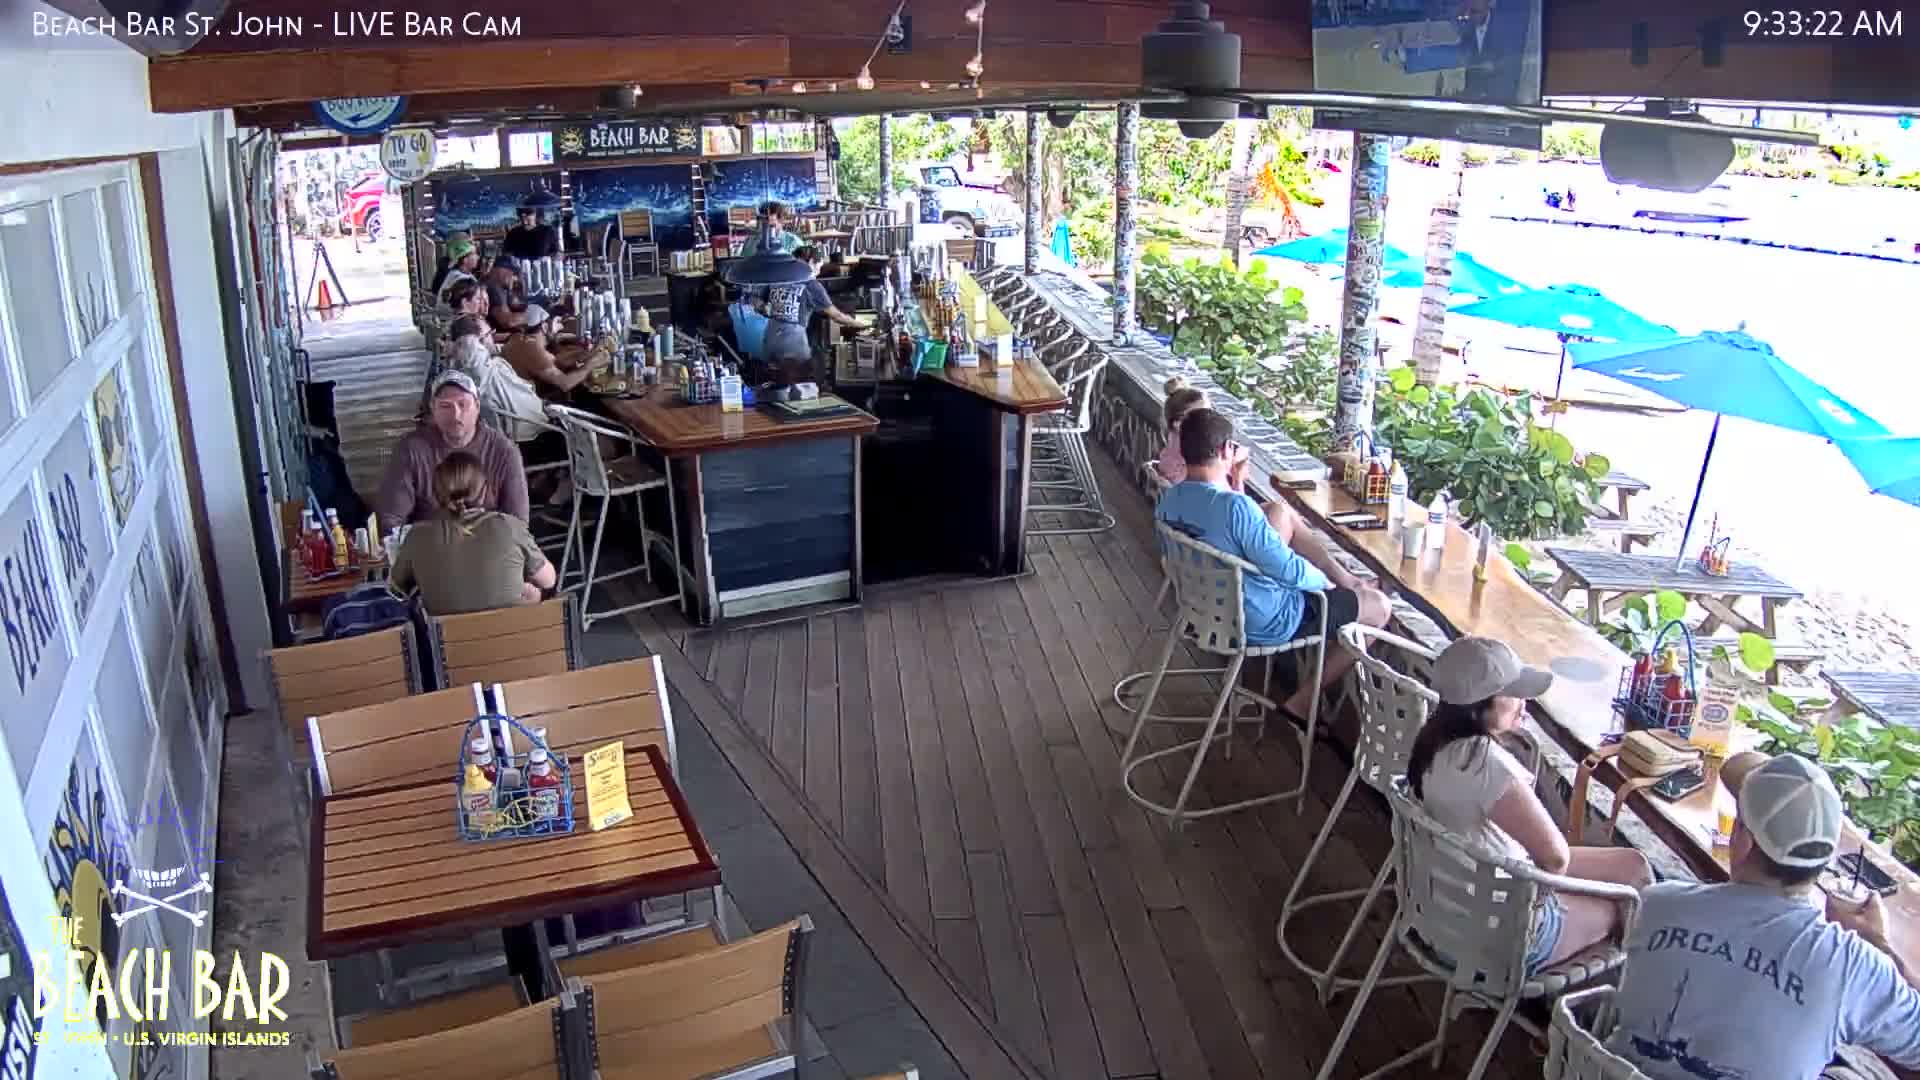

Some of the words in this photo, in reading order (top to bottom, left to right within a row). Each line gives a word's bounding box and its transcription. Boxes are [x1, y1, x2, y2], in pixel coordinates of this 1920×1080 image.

[390, 135, 406, 154] TO
[410, 132, 427, 152] GO
[590, 127, 634, 147] BEACH
[639, 126, 670, 146] BAR
[1648, 926, 1736, 963] ORCA
[1743, 946, 1805, 1005] BAR
